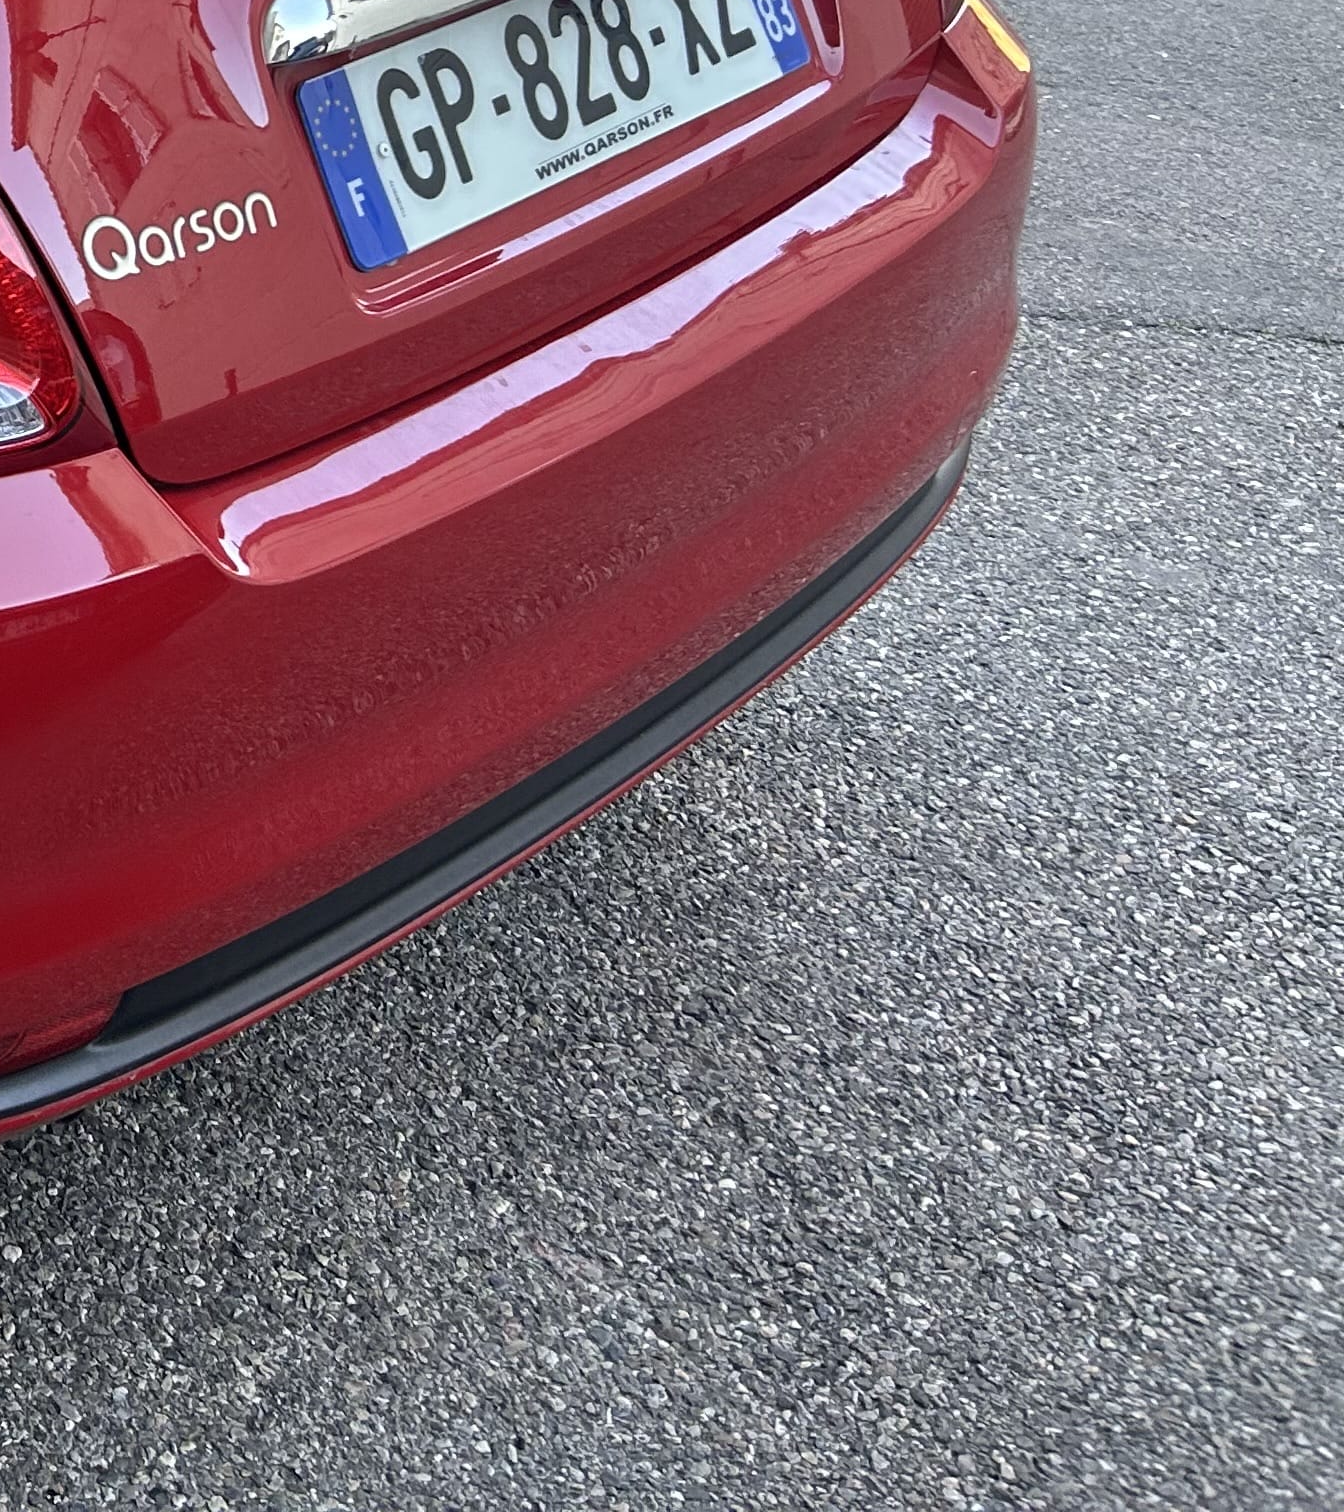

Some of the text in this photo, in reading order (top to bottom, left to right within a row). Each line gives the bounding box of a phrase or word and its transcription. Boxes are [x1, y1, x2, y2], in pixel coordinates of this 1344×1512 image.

[534, 104, 675, 181] WWW.QARSON.FR
[346, 177, 366, 217] F
[82, 191, 278, 281] Qarson
